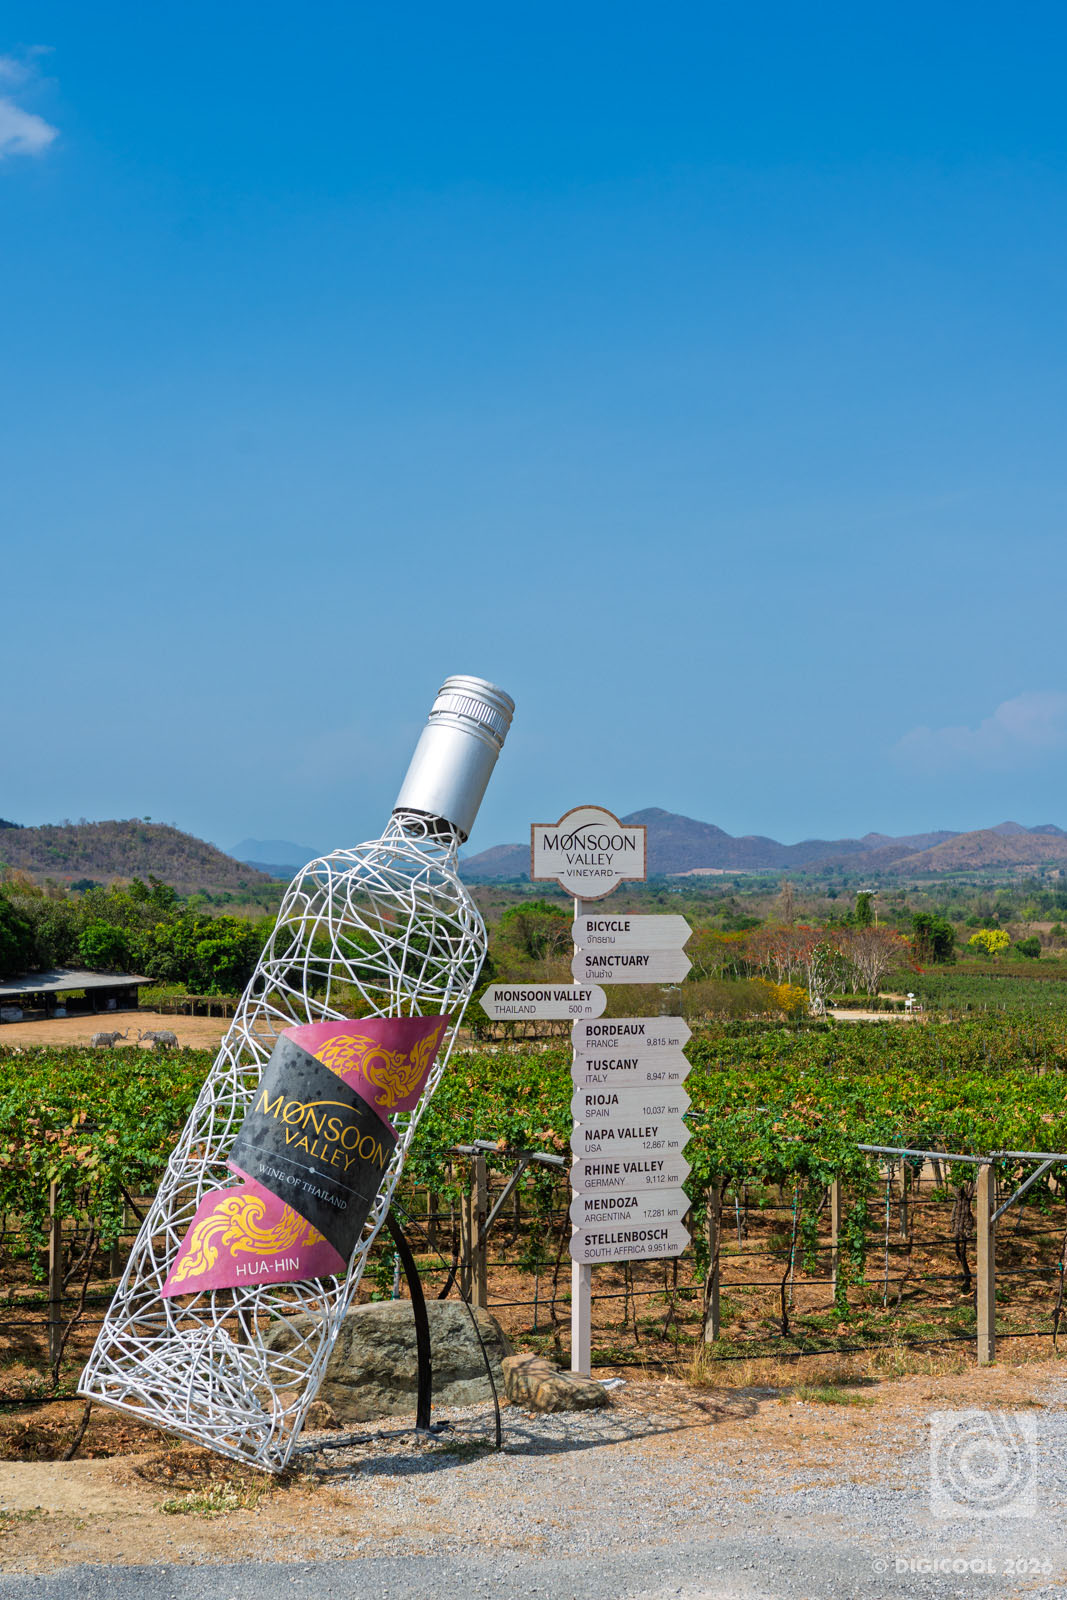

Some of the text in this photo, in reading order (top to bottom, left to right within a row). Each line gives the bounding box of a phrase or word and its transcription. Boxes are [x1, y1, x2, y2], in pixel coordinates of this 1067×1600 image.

[544, 834, 635, 851] MONSOON
[566, 854, 614, 865] VALLEY
[586, 921, 630, 932] BICYCLE
[587, 935, 615, 944] จักรยาน
[585, 955, 649, 966] SANCTUARY
[494, 990, 592, 1001] MONSOON VALLEY
[494, 1005, 536, 1014] THAILAND
[568, 1005, 582, 1014] 500
[586, 1024, 645, 1036] BORDEAUX
[586, 1039, 618, 1048] FRANCE
[646, 1038, 666, 1046] 9,815
[586, 1059, 639, 1071] TUSCANY
[585, 1074, 608, 1083] ITALY
[585, 1094, 619, 1106] RIOJA
[585, 1109, 610, 1118] SPAIN
[643, 1106, 666, 1115] 10,037
[255, 1090, 390, 1170] MONSOON
[585, 1126, 658, 1140] NAPA VALLEY
[286, 1127, 356, 1171] VALLEY
[585, 1144, 602, 1152] USA
[642, 1141, 665, 1150] 12,867
[584, 1161, 664, 1176] RHINE VALLEY
[259, 1164, 347, 1210] WINE OF THAILAND
[584, 1177, 626, 1188] GERMANY
[646, 1175, 665, 1184] 9,112
[584, 1197, 638, 1210] MENDOZA
[584, 1212, 631, 1222] ARGENTINA
[584, 1229, 668, 1246] STELLENBOSCH
[584, 1247, 611, 1258] SOUTH
[648, 1244, 666, 1252] 9,951
[236, 1257, 299, 1277] HUA-HIN
